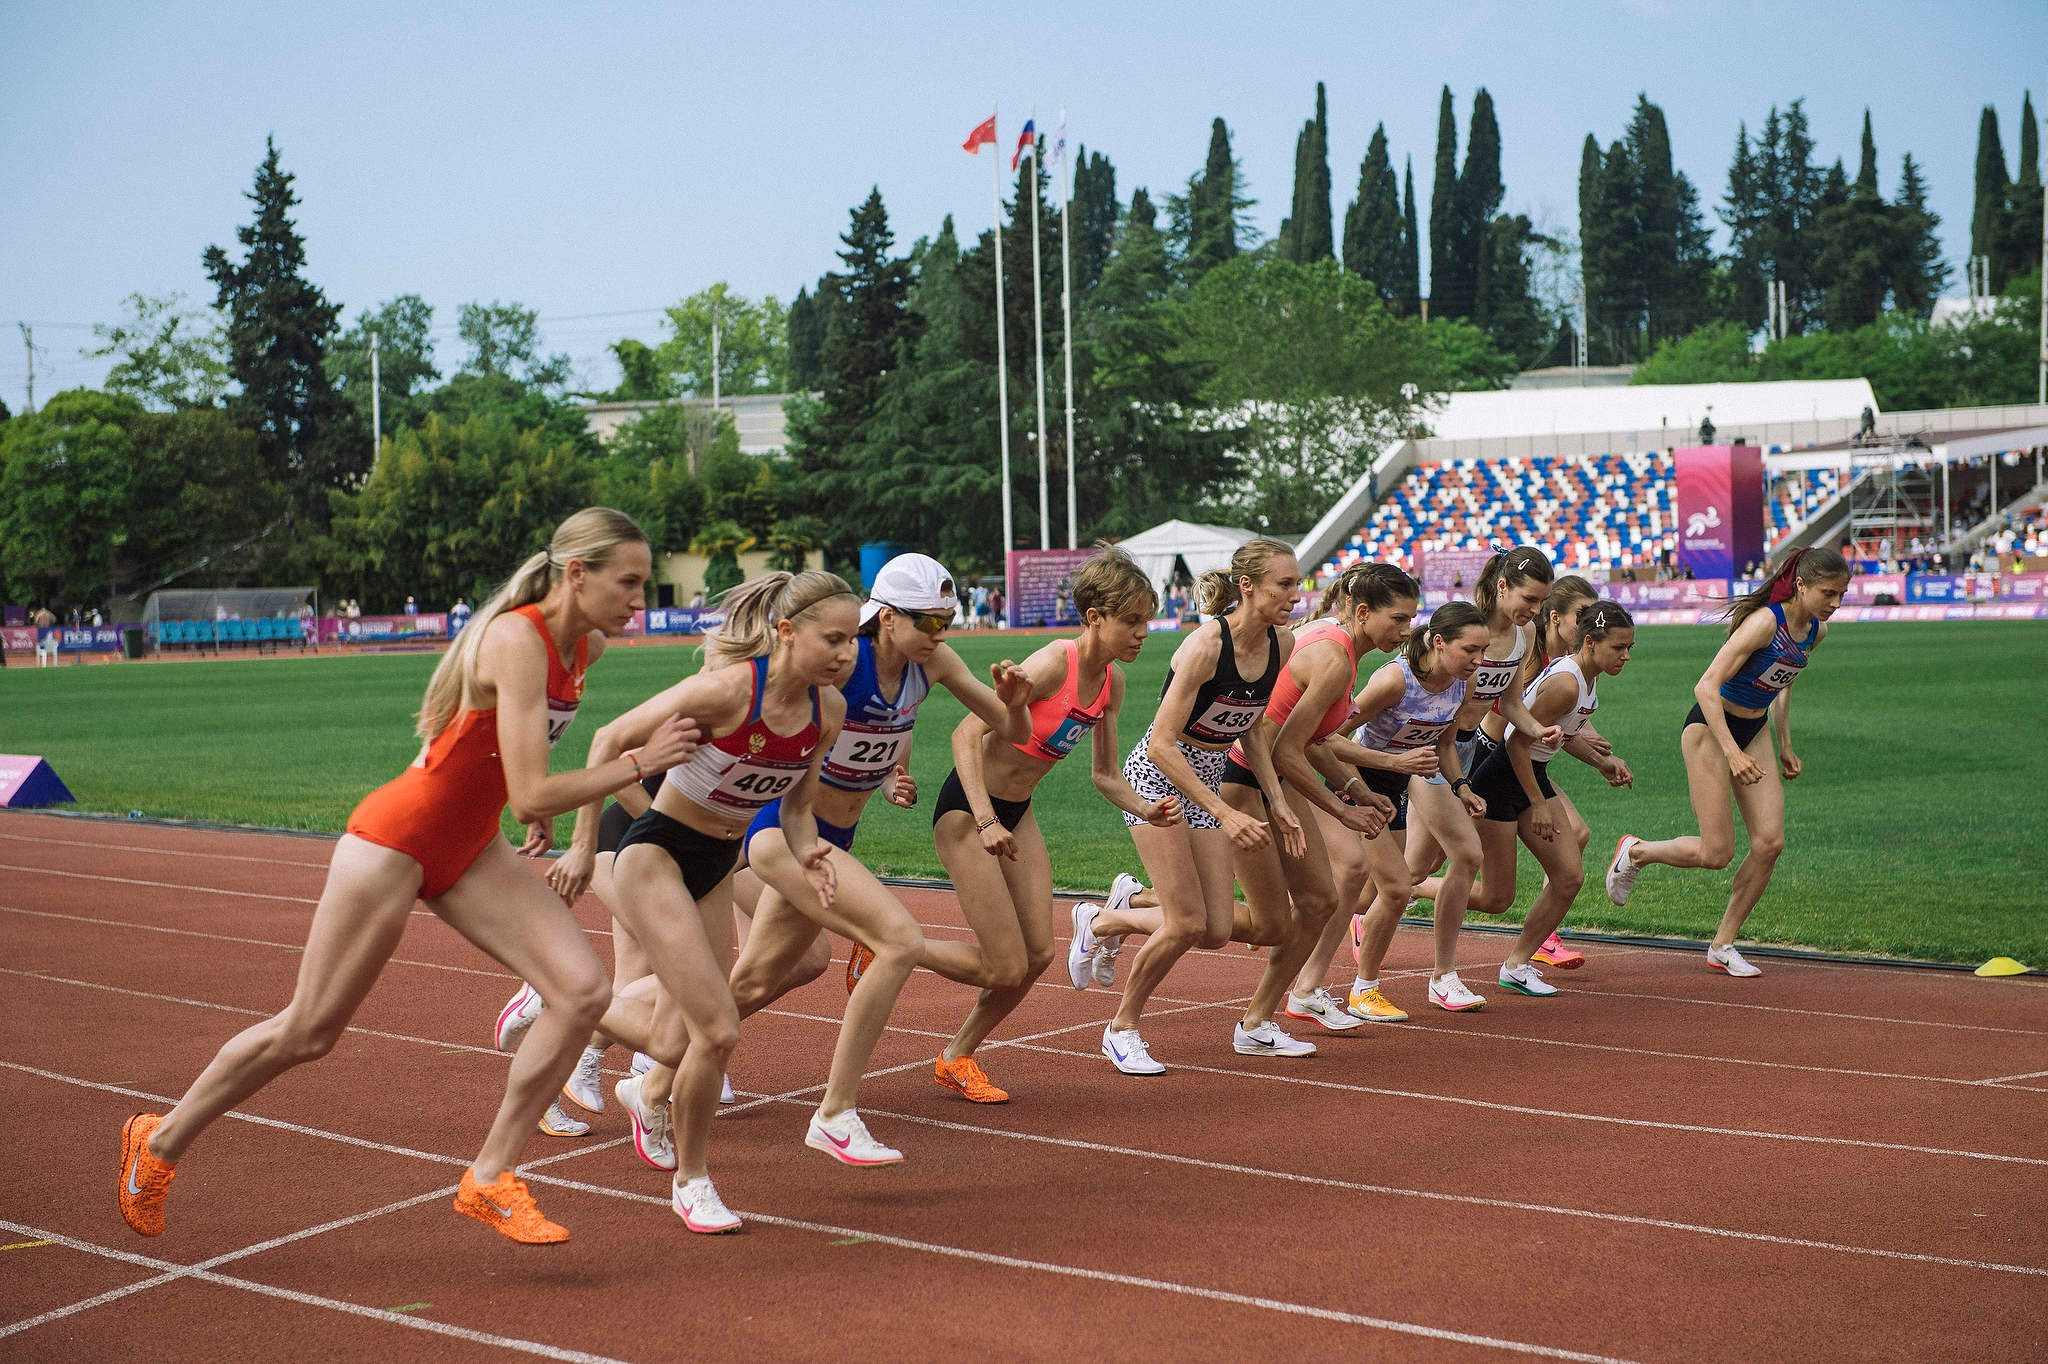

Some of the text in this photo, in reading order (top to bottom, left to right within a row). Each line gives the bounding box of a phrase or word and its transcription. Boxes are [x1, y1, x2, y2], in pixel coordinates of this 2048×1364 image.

[1477, 671, 1511, 688] 340
[1212, 710, 1255, 728] 438
[1475, 727, 1498, 751] PRO
[848, 739, 900, 763] 221
[733, 773, 793, 794] 409
